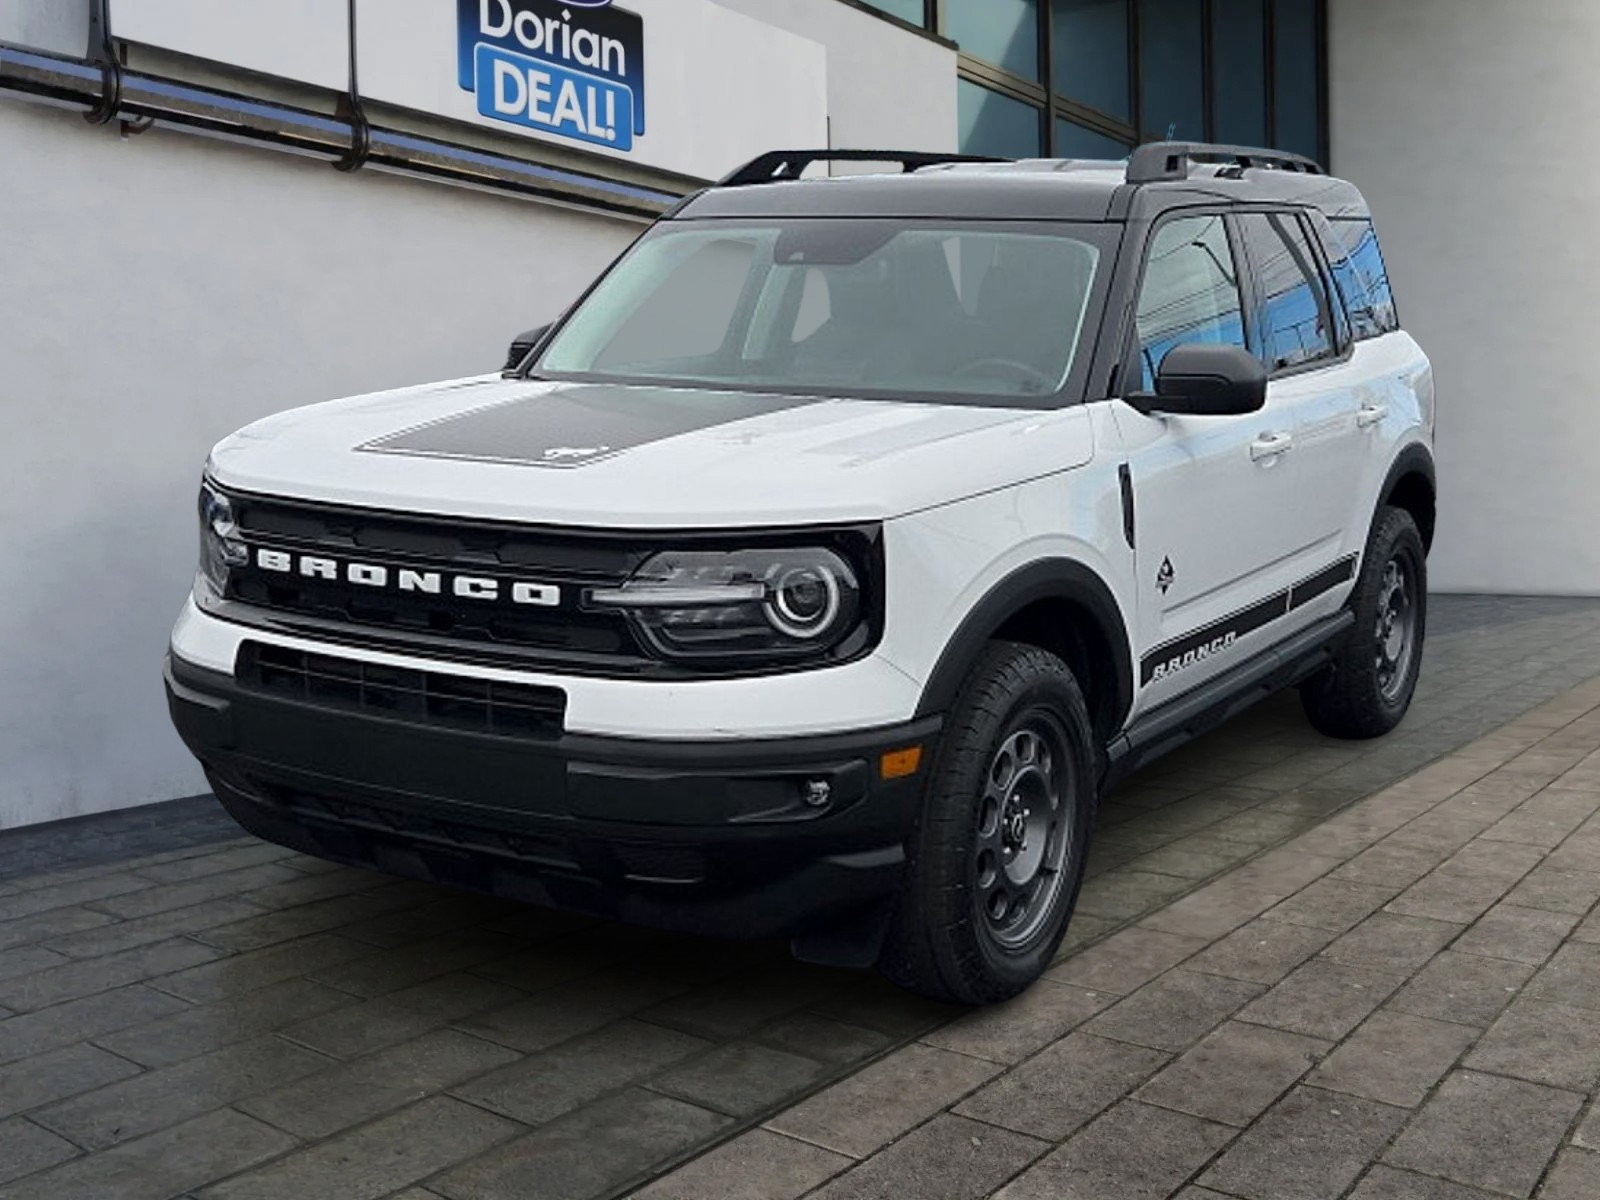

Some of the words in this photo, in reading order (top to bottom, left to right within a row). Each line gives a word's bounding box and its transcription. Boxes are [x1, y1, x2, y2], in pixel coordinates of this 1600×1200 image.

[480, 0, 626, 77] Dorian
[493, 58, 617, 142] DEAL!
[257, 548, 561, 606] BRONCO
[1152, 631, 1237, 682] BRONCO
